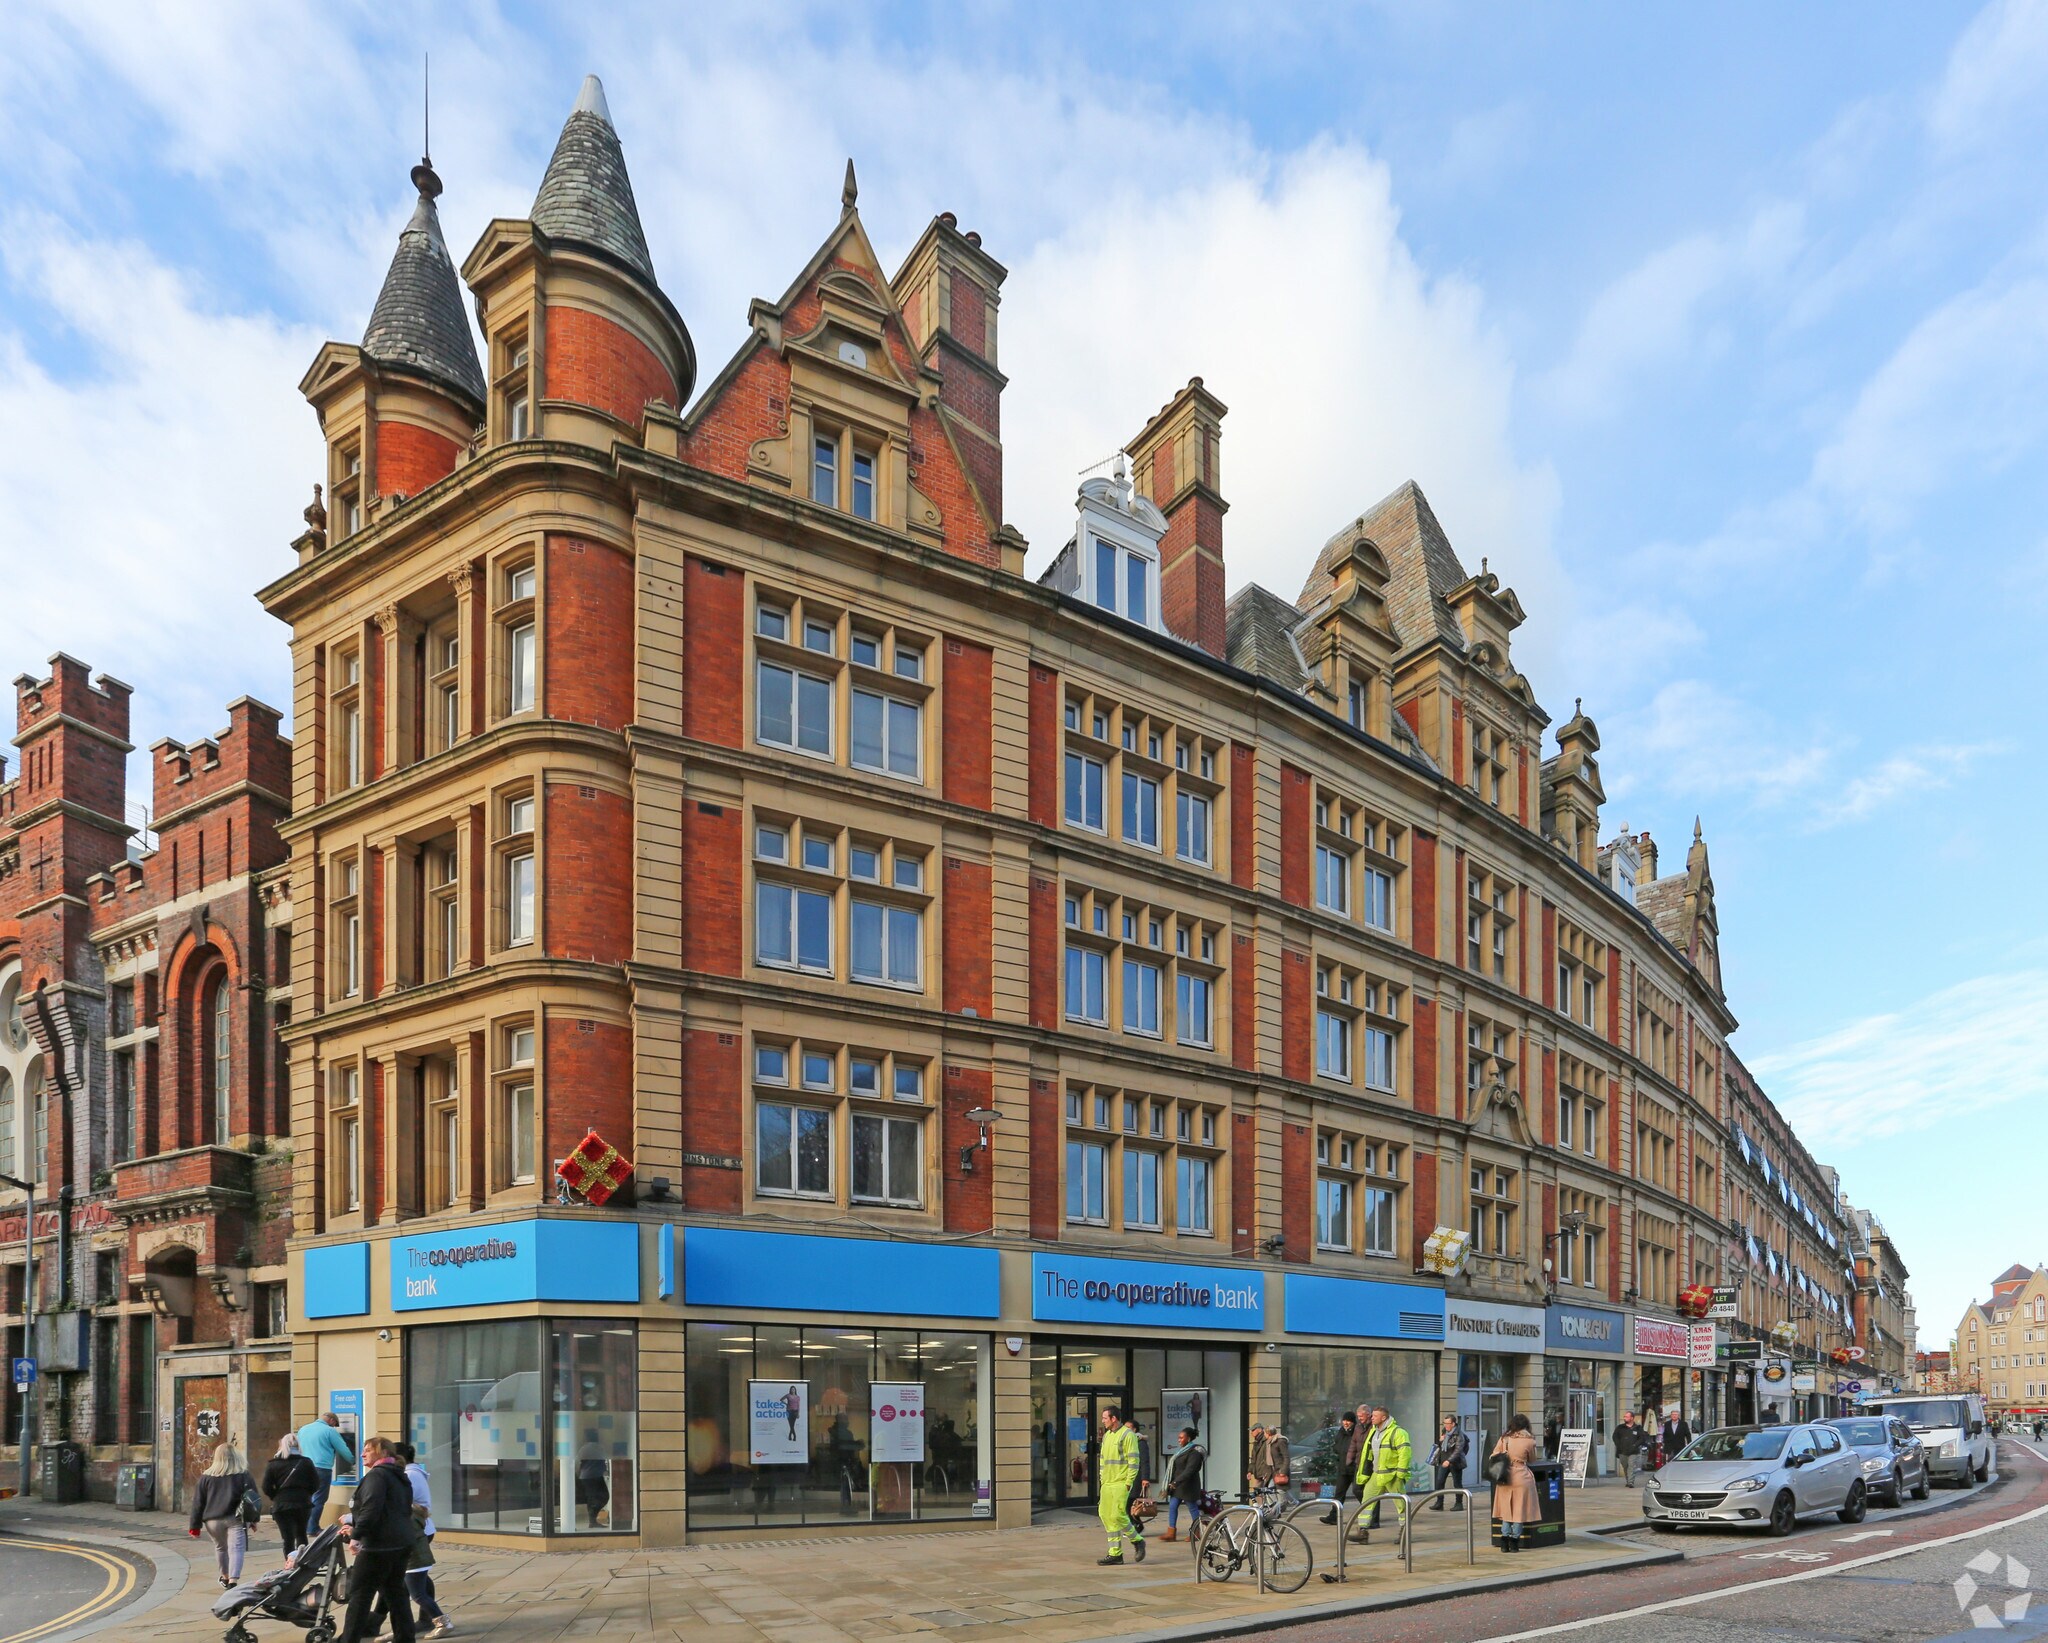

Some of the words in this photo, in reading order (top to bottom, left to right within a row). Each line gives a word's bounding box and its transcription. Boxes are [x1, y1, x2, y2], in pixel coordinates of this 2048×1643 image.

[407, 1248, 428, 1268] The
[429, 1238, 517, 1268] co-operative
[406, 1274, 437, 1297] bank
[1042, 1270, 1079, 1298] The
[1083, 1281, 1211, 1308] co-operative
[1214, 1283, 1258, 1310] bank
[1560, 1315, 1611, 1340] TONI&GUY
[755, 1399, 785, 1409] takes
[755, 1409, 789, 1419] action
[1670, 1510, 1689, 1518] YP66
